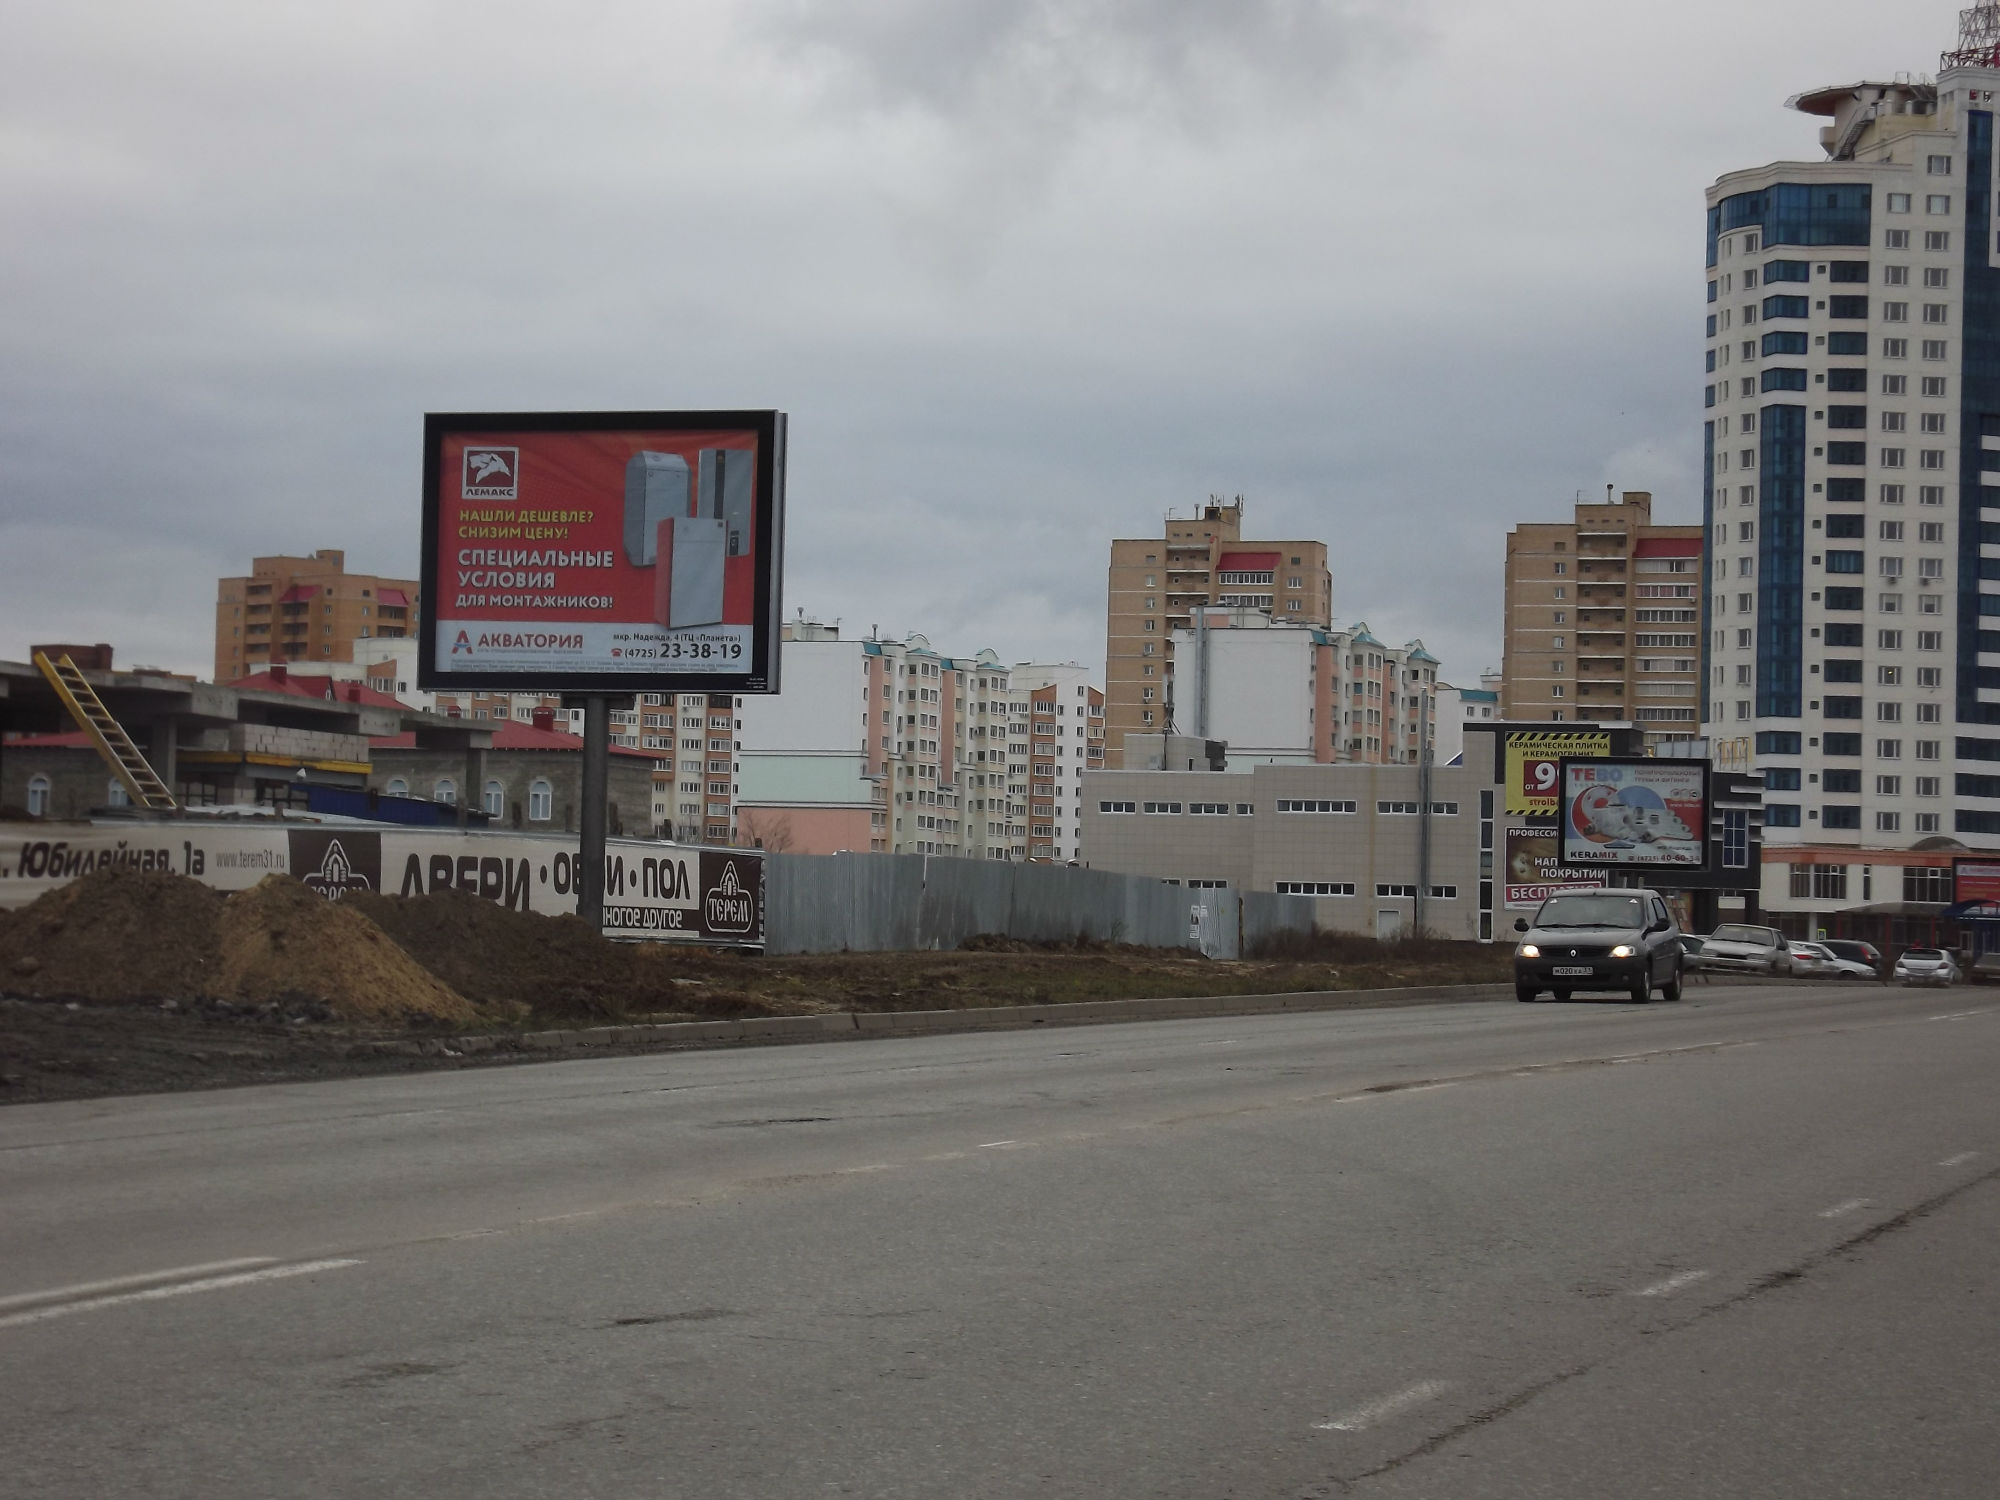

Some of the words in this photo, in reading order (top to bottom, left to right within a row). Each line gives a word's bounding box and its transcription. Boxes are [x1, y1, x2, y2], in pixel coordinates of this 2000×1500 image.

[465, 488, 514, 497] ЛЕМАКС
[460, 510, 515, 522] НАШЛИ
[518, 510, 594, 523] ДЕШЕВЛЕ?
[458, 526, 521, 539] СНИЗИМ
[525, 527, 568, 540] ЦЕНУ!
[458, 549, 614, 568] СПЕЦИАЛЬНЫЕ
[457, 571, 556, 588] УСЛОВИЯ
[455, 594, 486, 608] ДЛЯ
[489, 595, 613, 609] МОНТАЖНИКОВ!
[478, 633, 584, 649] АКВАТОРИЯ
[613, 634, 632, 643] мкр.
[674, 633, 679, 641] 4
[680, 633, 695, 643] (ТЦ
[624, 648, 657, 659] (4725)
[660, 642, 742, 660] 23-38-19
[1509, 741, 1574, 750] КЕРАМИЧЕСКАЯ
[1575, 742, 1608, 750] ПЛИТКА
[1509, 829, 1559, 837] ПРОФЕССИ
[215, 849, 285, 868] www.terem31.ru
[1570, 851, 1619, 859] KERAMIX
[642, 857, 691, 900] ПОЛ
[708, 898, 749, 923] ТЕРЕМ
